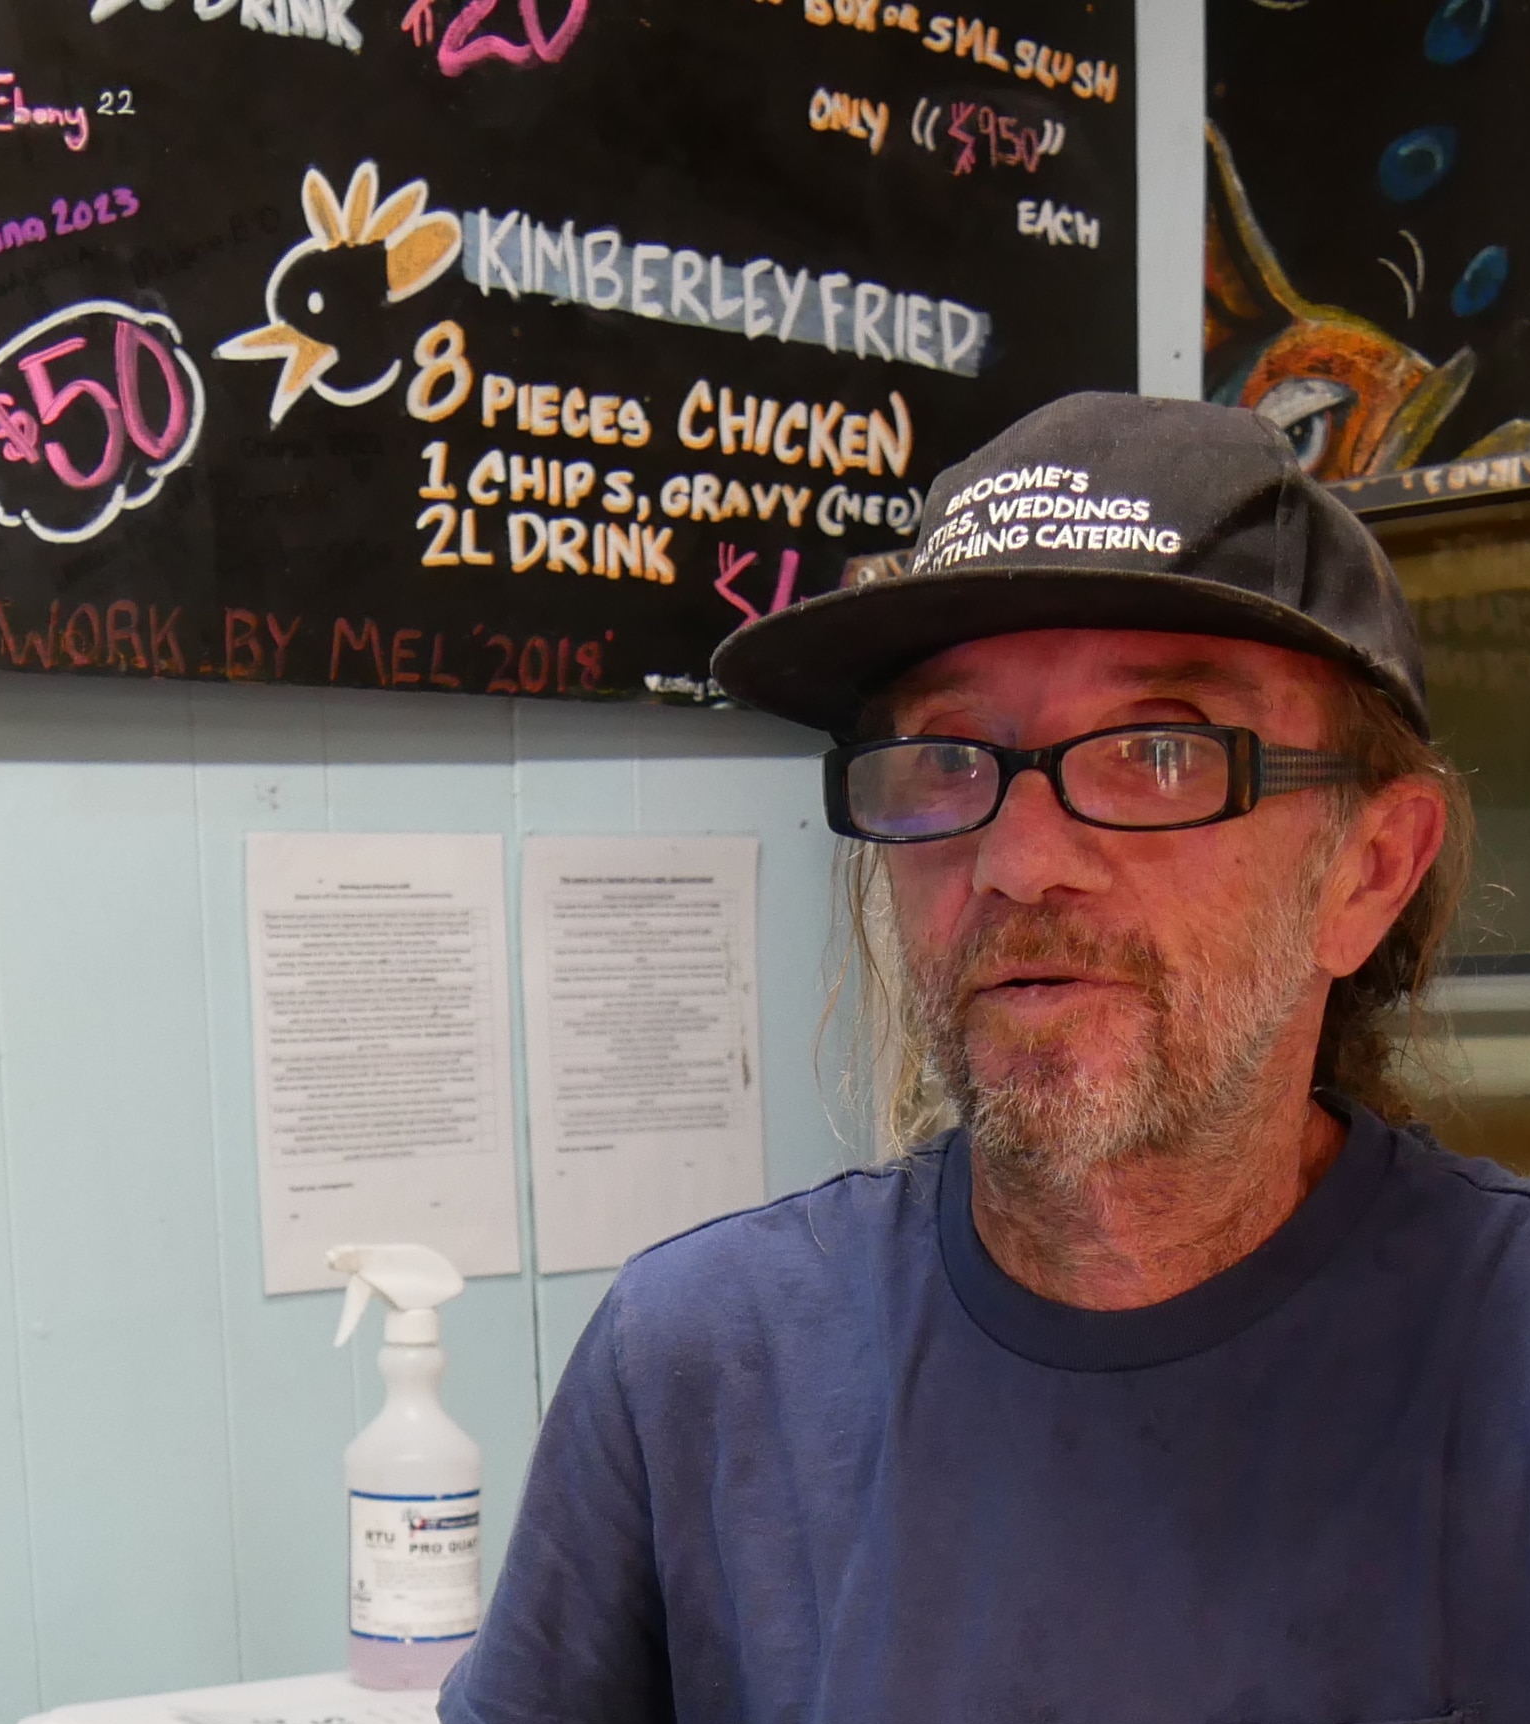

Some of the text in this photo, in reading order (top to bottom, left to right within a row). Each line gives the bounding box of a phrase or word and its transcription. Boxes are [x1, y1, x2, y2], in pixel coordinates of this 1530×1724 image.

[922, 15, 1119, 104] SML SLUSH
[96, 90, 137, 117] 22
[809, 87, 891, 155] ONLY
[1017, 199, 1100, 249] EACH
[475, 207, 982, 371] KIMBERLEY FRIED
[406, 320, 915, 479] 8 PIECES CHICKEN
[418, 440, 456, 501] 1
[667, 473, 813, 527] GRAVY
[987, 494, 1151, 525] WEDDINGS
[416, 504, 675, 584] 2L DRINK
[1034, 523, 1182, 554] CATERING
[223, 604, 303, 671] BY
[329, 616, 464, 693] MEL
